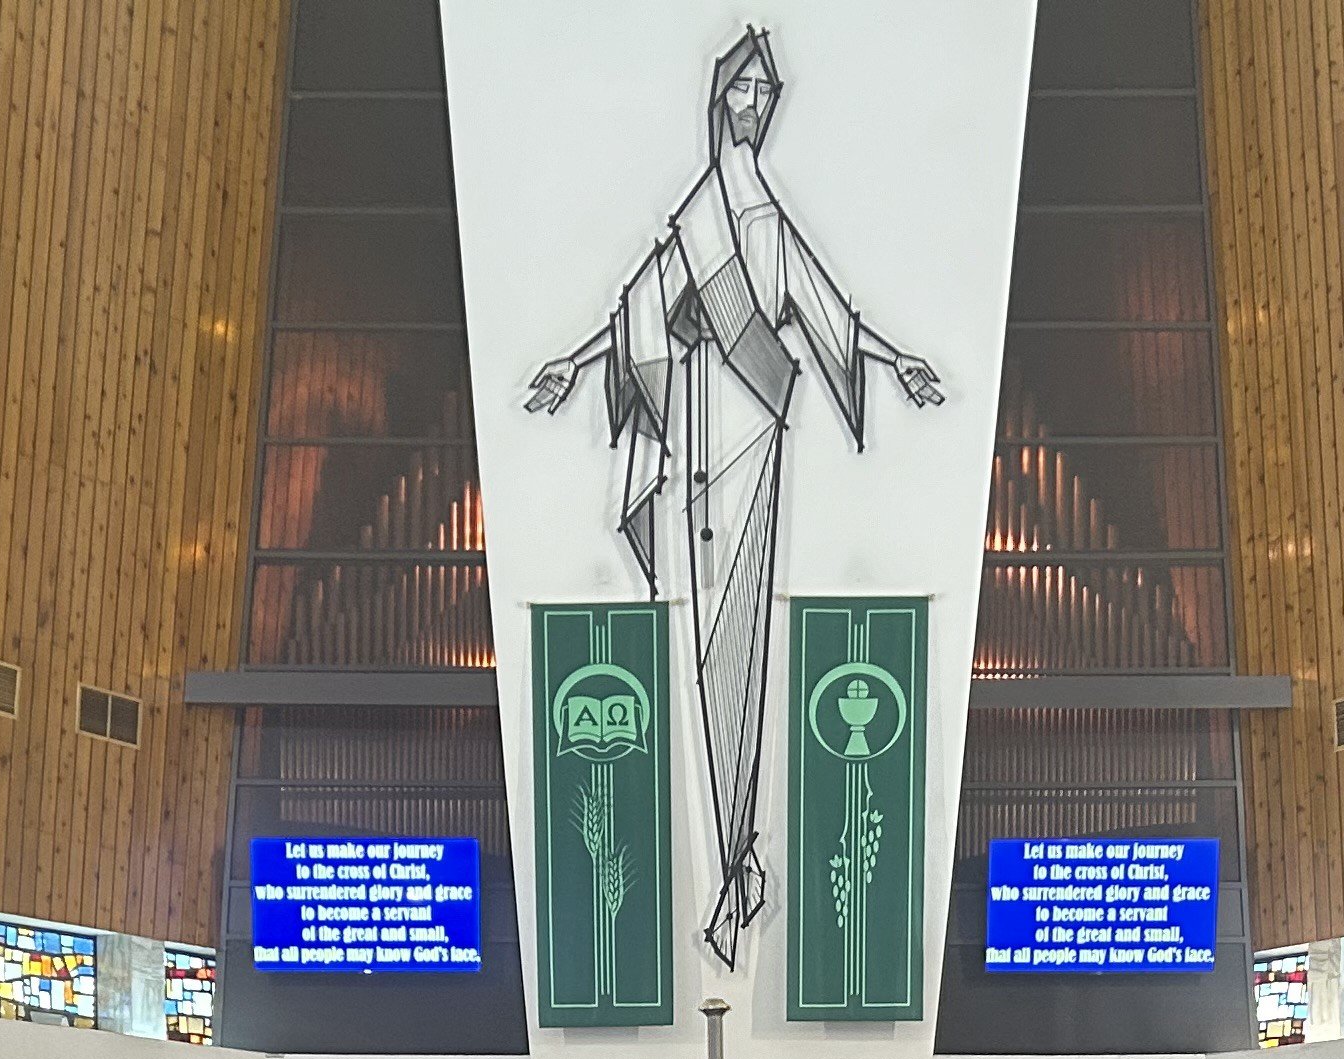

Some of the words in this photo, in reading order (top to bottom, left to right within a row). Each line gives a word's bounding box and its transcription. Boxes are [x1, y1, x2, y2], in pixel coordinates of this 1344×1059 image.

[607, 703, 629, 726] Ω
[285, 842, 306, 858] Let
[309, 844, 325, 858] us
[327, 842, 364, 859] make
[367, 844, 391, 859] our
[394, 842, 444, 861] journey
[1024, 842, 1044, 859] Let
[1047, 844, 1062, 859] us
[1065, 842, 1103, 859] make
[1106, 844, 1130, 859] our
[1132, 842, 1184, 861] journey
[296, 864, 311, 879] to
[313, 864, 335, 879] the
[337, 866, 371, 879] cross
[372, 863, 387, 879] of
[389, 863, 430, 881] Christ,
[1034, 864, 1047, 880] to
[1050, 864, 1072, 880] the
[1075, 866, 1108, 880] cross
[1111, 864, 1125, 880] of
[1127, 864, 1168, 881] Christ,
[255, 884, 285, 900] who
[286, 884, 367, 900] surrendered
[369, 884, 403, 902] glory
[406, 884, 433, 901] and
[435, 885, 472, 902] grace
[991, 885, 1019, 901] who
[1022, 885, 1102, 901] surrendered
[1106, 885, 1140, 902] glory
[1143, 885, 1169, 900] and
[1172, 885, 1210, 902] grace
[301, 905, 315, 921] to
[318, 905, 369, 921] become
[371, 907, 381, 921] a
[384, 905, 432, 921] servant
[1036, 906, 1049, 921] to
[1052, 906, 1104, 921] become
[1107, 908, 1116, 921] a
[1119, 906, 1168, 921] servant
[302, 925, 316, 941] of
[319, 926, 341, 941] the
[343, 926, 378, 943] great
[381, 926, 407, 941] and
[409, 926, 449, 943] small,
[1035, 926, 1049, 942] of
[1052, 926, 1074, 942] the
[1077, 927, 1112, 944] great
[1115, 926, 1141, 942] and
[1144, 926, 1184, 943] small,
[254, 946, 279, 962] that
[281, 946, 299, 962] all
[301, 946, 345, 964] people
[346, 948, 374, 964] may
[376, 946, 411, 962] know
[413, 946, 449, 962] God's
[450, 946, 482, 963] face.
[986, 947, 1011, 963] that
[1013, 947, 1031, 963] all
[1033, 947, 1076, 965] people
[1079, 949, 1106, 965] may
[1109, 947, 1145, 963] know
[1147, 947, 1182, 963] God's
[1184, 947, 1215, 963] face.
